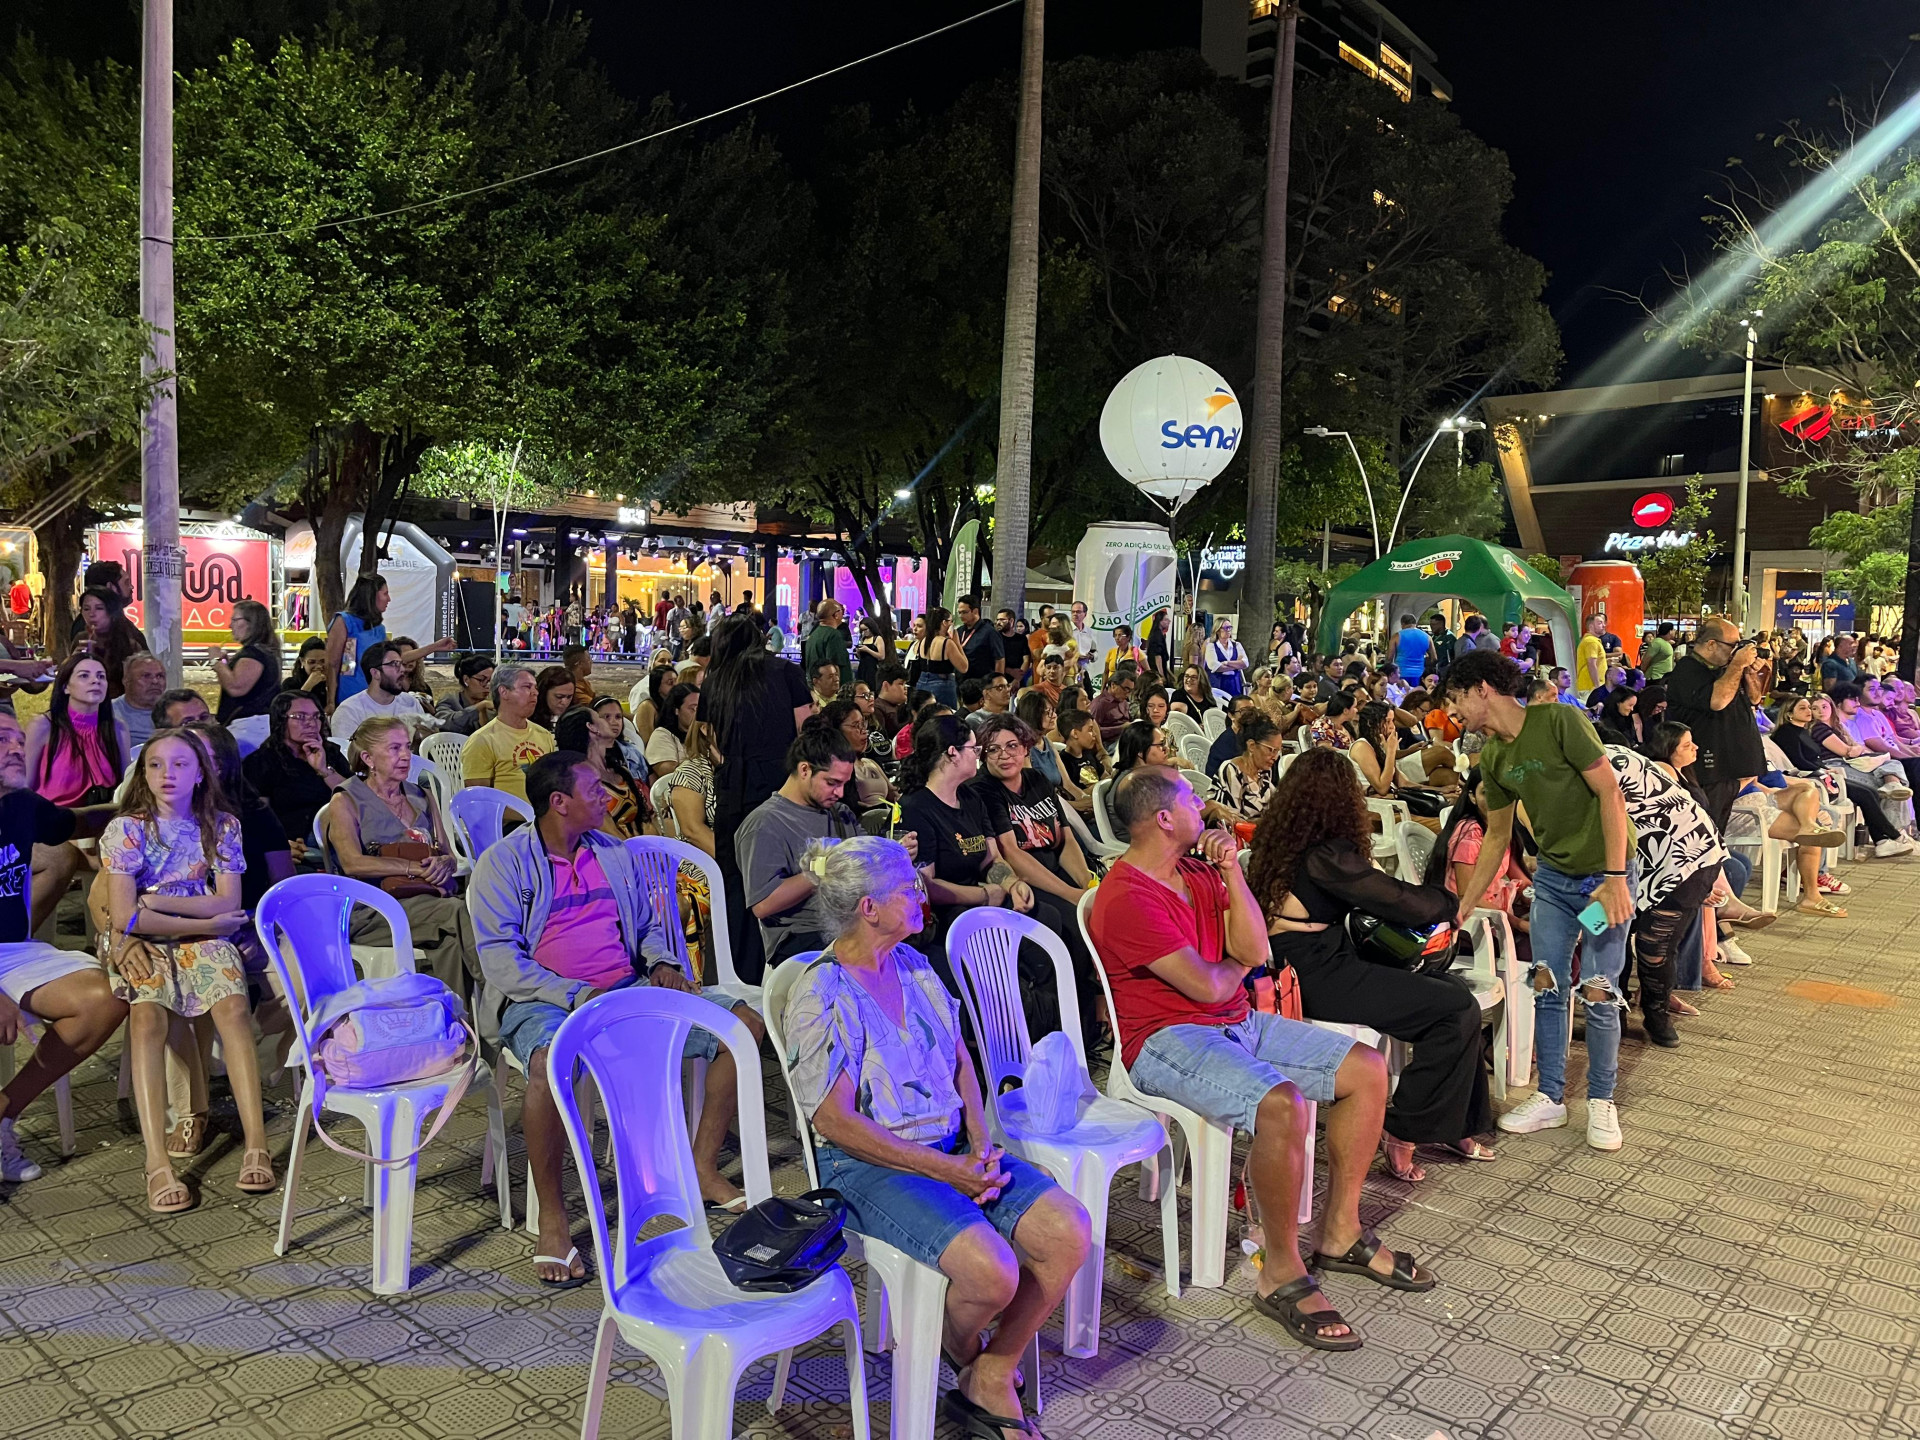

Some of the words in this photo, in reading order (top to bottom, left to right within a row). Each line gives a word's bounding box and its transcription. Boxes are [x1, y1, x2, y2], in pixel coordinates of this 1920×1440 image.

[1604, 532, 1656, 553] Pizza
[1415, 552, 1456, 567] GERALDO
[1098, 615, 1122, 626] SÃO
